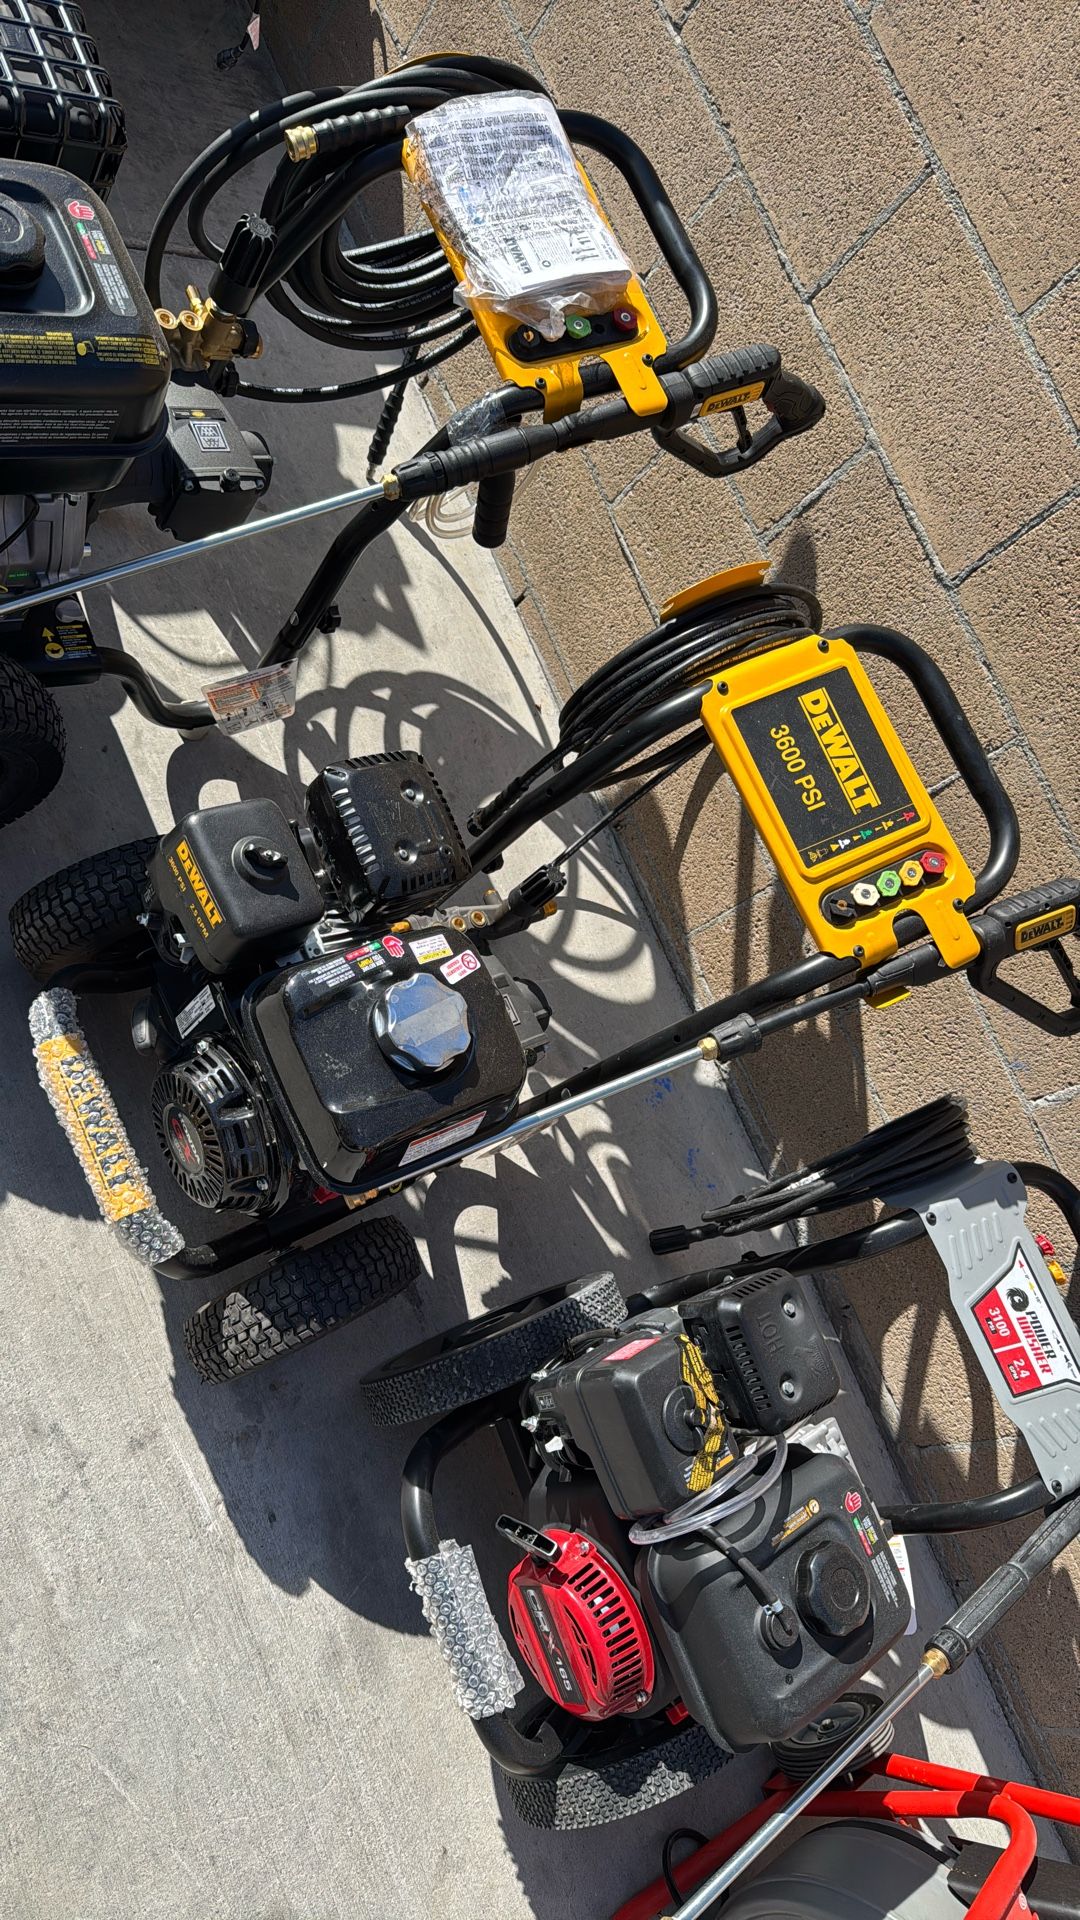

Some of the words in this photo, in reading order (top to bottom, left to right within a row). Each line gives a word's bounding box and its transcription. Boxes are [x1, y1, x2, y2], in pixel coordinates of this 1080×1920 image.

[768, 723, 807, 774] 3600
[793, 774, 825, 812] PSI
[798, 687, 879, 814] DEWALT
[167, 856, 180, 876] 3600
[176, 875, 186, 892] PSI
[175, 840, 223, 928] DEWALT
[196, 916, 208, 938] GPM
[1021, 916, 1062, 943] DEWALT
[170, 1117, 195, 1164] GX
[177, 1112, 201, 1164] HONDA
[986, 1320, 996, 1331] PSI
[1007, 1365, 1019, 1379] GPM
[987, 1306, 1011, 1337] 3100
[1012, 1358, 1030, 1378] 2.4
[1015, 1315, 1052, 1373] WASHER
[1025, 1310, 1057, 1359] POWER
[525, 1588, 560, 1654] CRX
[553, 1657, 572, 1692] 165
